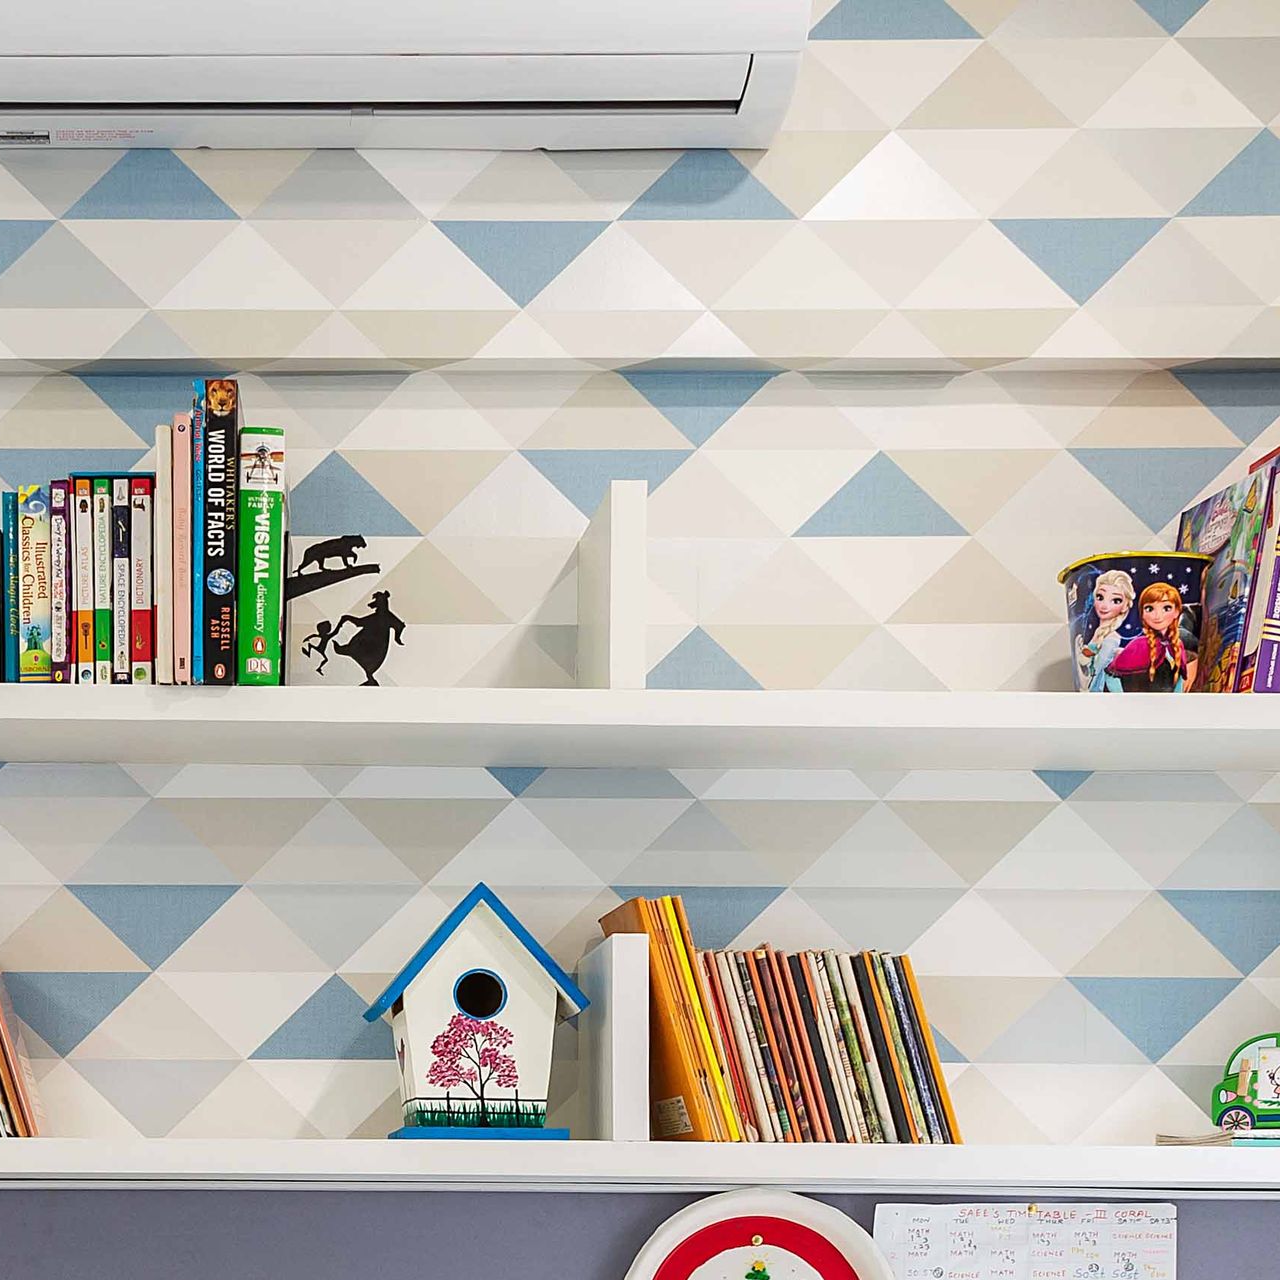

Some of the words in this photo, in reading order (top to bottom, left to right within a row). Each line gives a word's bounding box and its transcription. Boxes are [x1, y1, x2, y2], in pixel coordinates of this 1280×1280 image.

[207, 429, 226, 484] WORLD
[207, 488, 225, 505] OF
[225, 457, 235, 531] WHITAKER'S
[22, 516, 35, 562] Classics
[207, 512, 225, 557] FACTS
[254, 511, 271, 583] VISUAL
[35, 542, 48, 600] Illustrated
[136, 558, 144, 605] DICTIONARY
[22, 573, 35, 625] Children
[254, 583, 268, 632] dictionary
[211, 619, 220, 639] ASH
[220, 606, 230, 651] RUSSELL
[249, 658, 268, 672] DK
